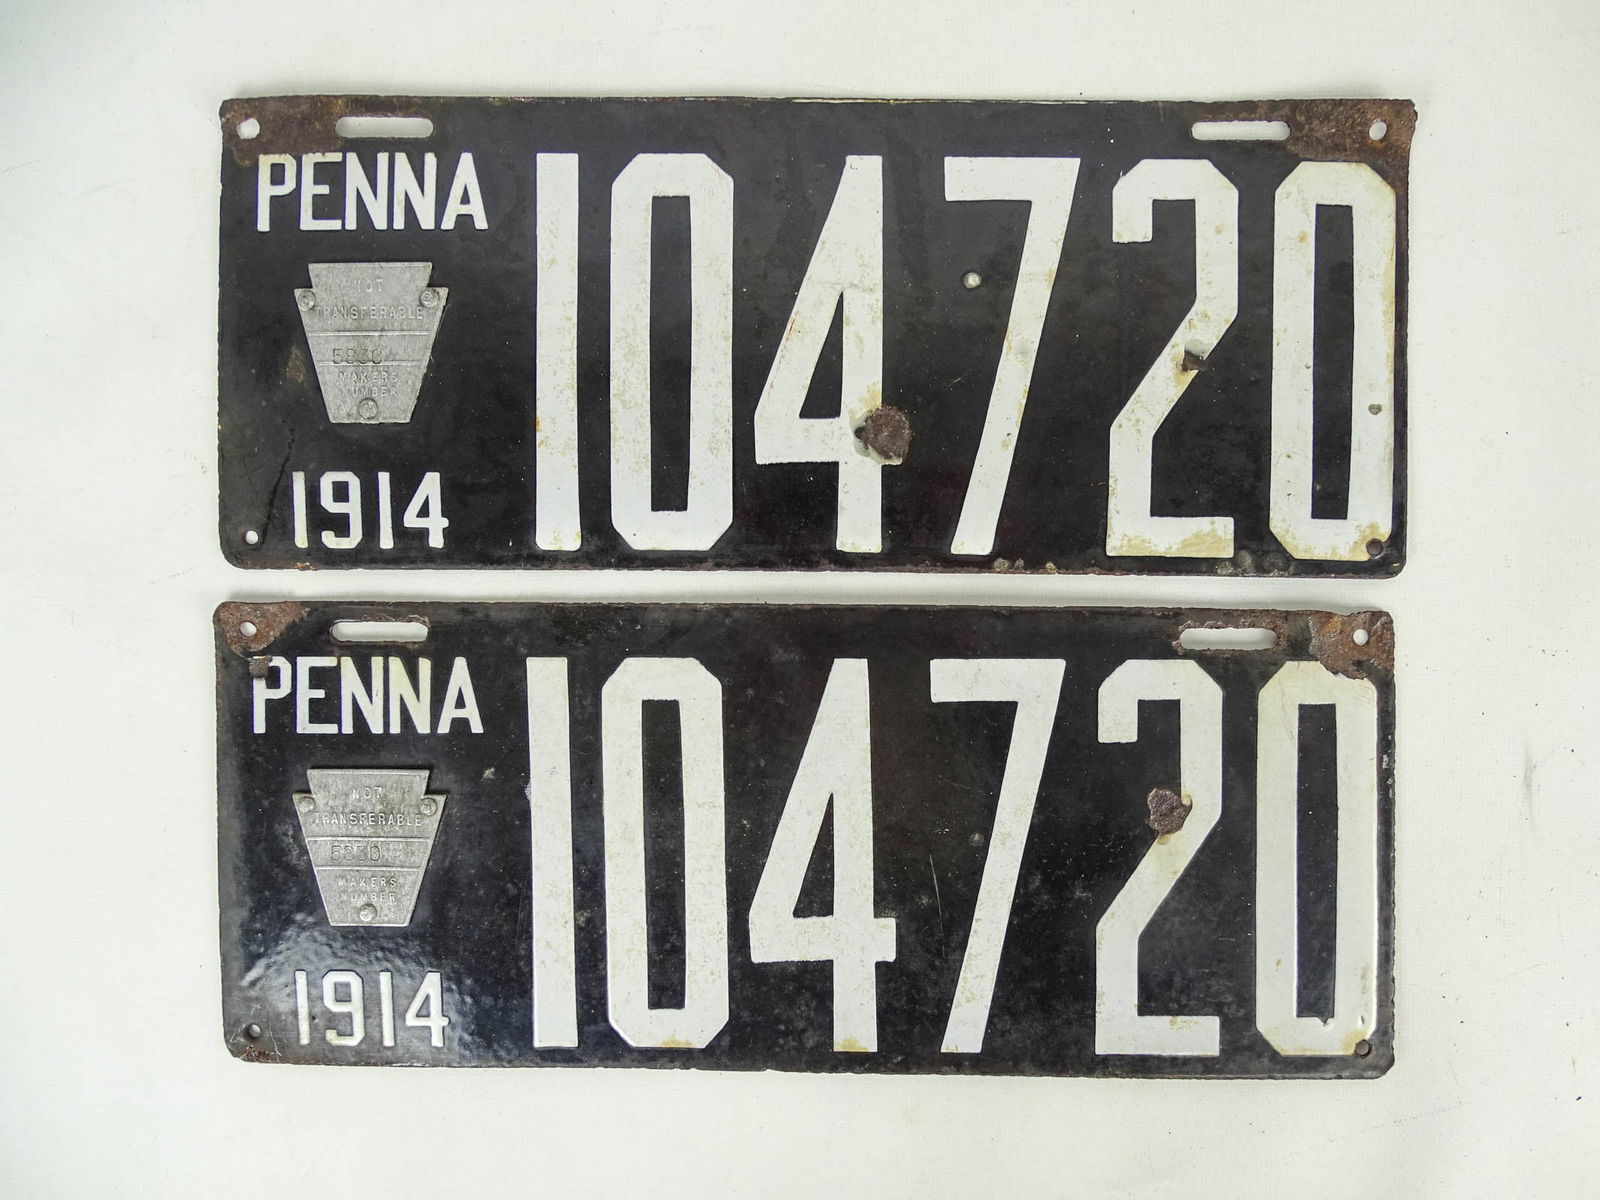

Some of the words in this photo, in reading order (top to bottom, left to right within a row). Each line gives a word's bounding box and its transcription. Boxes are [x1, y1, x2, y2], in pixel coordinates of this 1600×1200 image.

[257, 152, 488, 231] PENNA
[316, 306, 424, 320] TRANSFERABLE
[339, 372, 398, 384] MAKERS
[535, 153, 1396, 561] 104720
[293, 471, 449, 549] 1914
[252, 656, 483, 734] PENNA
[353, 787, 384, 799] NOT
[314, 813, 421, 827] TRANSFERABLE
[525, 657, 1380, 1056] 104720
[339, 877, 397, 888] MAKERS
[339, 891, 396, 902] NUMBER
[296, 970, 449, 1048] 1914
